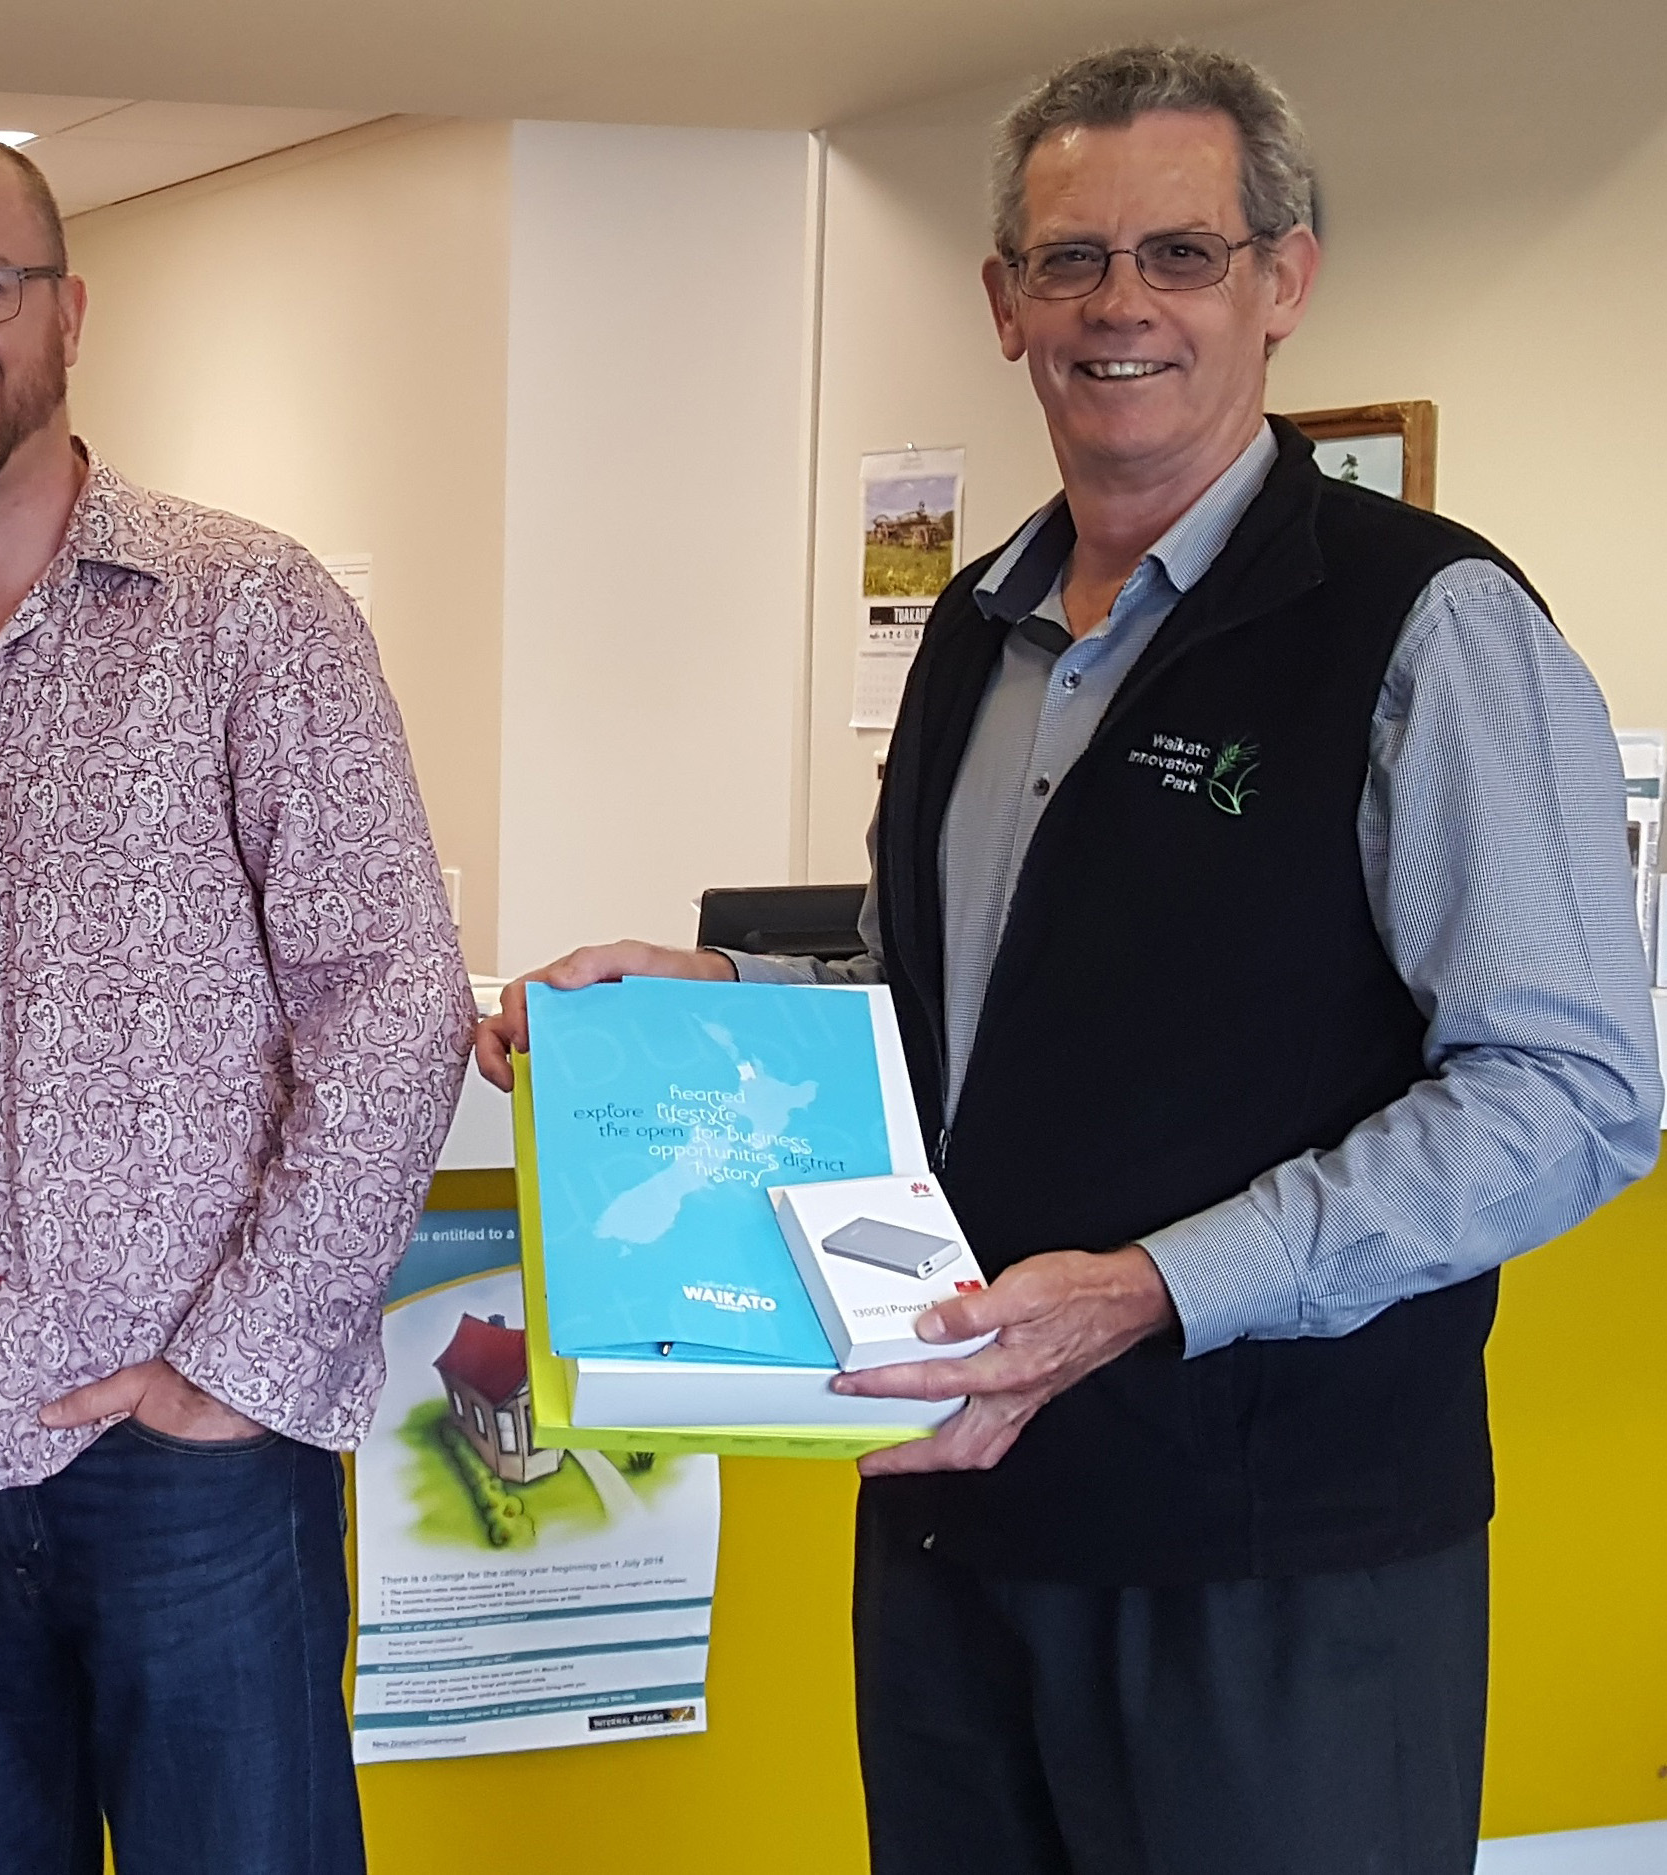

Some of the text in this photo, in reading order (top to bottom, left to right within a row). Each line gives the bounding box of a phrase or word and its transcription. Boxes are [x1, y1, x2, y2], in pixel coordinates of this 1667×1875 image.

[1153, 734, 1211, 758] Waikato
[1162, 773, 1198, 794] Park
[669, 1084, 746, 1110] hearted
[574, 1102, 737, 1128] explore lifestyle
[599, 1121, 812, 1154] the open for business
[649, 1141, 846, 1174] opportunities district
[694, 1160, 775, 1187] history
[412, 1228, 515, 1242] ou entitled to a
[682, 1285, 777, 1312] WAIKATO
[890, 1303, 929, 1315] Power
[381, 1574, 408, 1585] There
[411, 1574, 419, 1583] is
[422, 1575, 428, 1583] a
[430, 1572, 465, 1583] change
[467, 1570, 480, 1580] for
[483, 1569, 498, 1579] the
[530, 1567, 548, 1577] year
[552, 1562, 597, 1575] beginning
[622, 1559, 640, 1569] July
